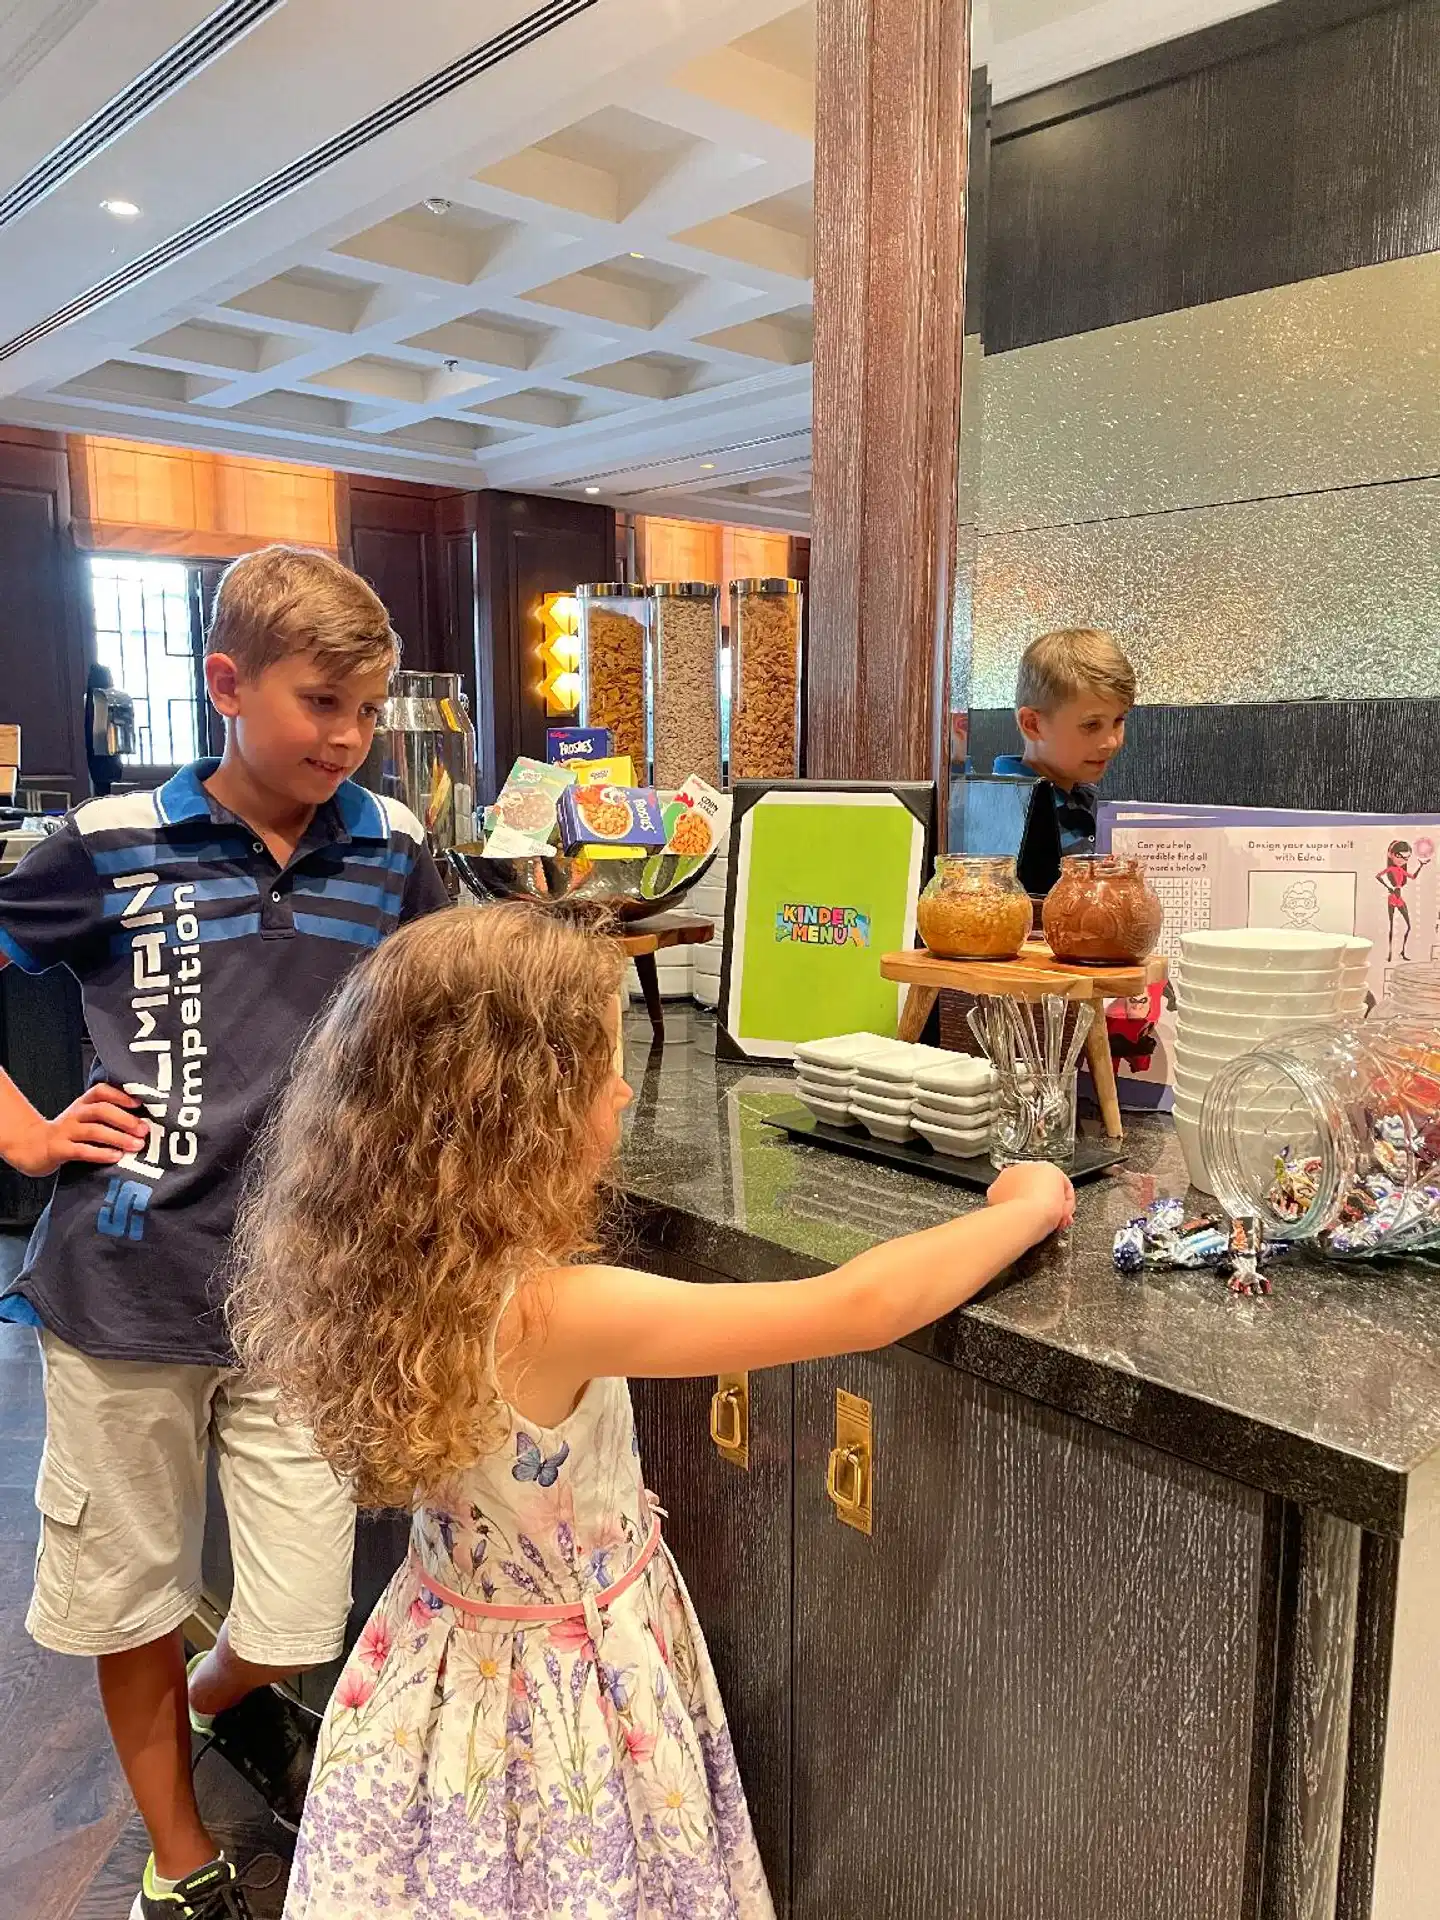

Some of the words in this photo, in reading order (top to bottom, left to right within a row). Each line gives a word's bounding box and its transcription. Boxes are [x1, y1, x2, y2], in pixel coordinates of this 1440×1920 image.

[1137, 841, 1154, 849] Can
[1282, 843, 1304, 852] your
[1177, 852, 1195, 861] find
[1196, 852, 1208, 861] all
[1275, 852, 1296, 862] with
[1175, 863, 1206, 873] below?
[783, 903, 859, 927] KINDER
[791, 923, 849, 945] MENU
